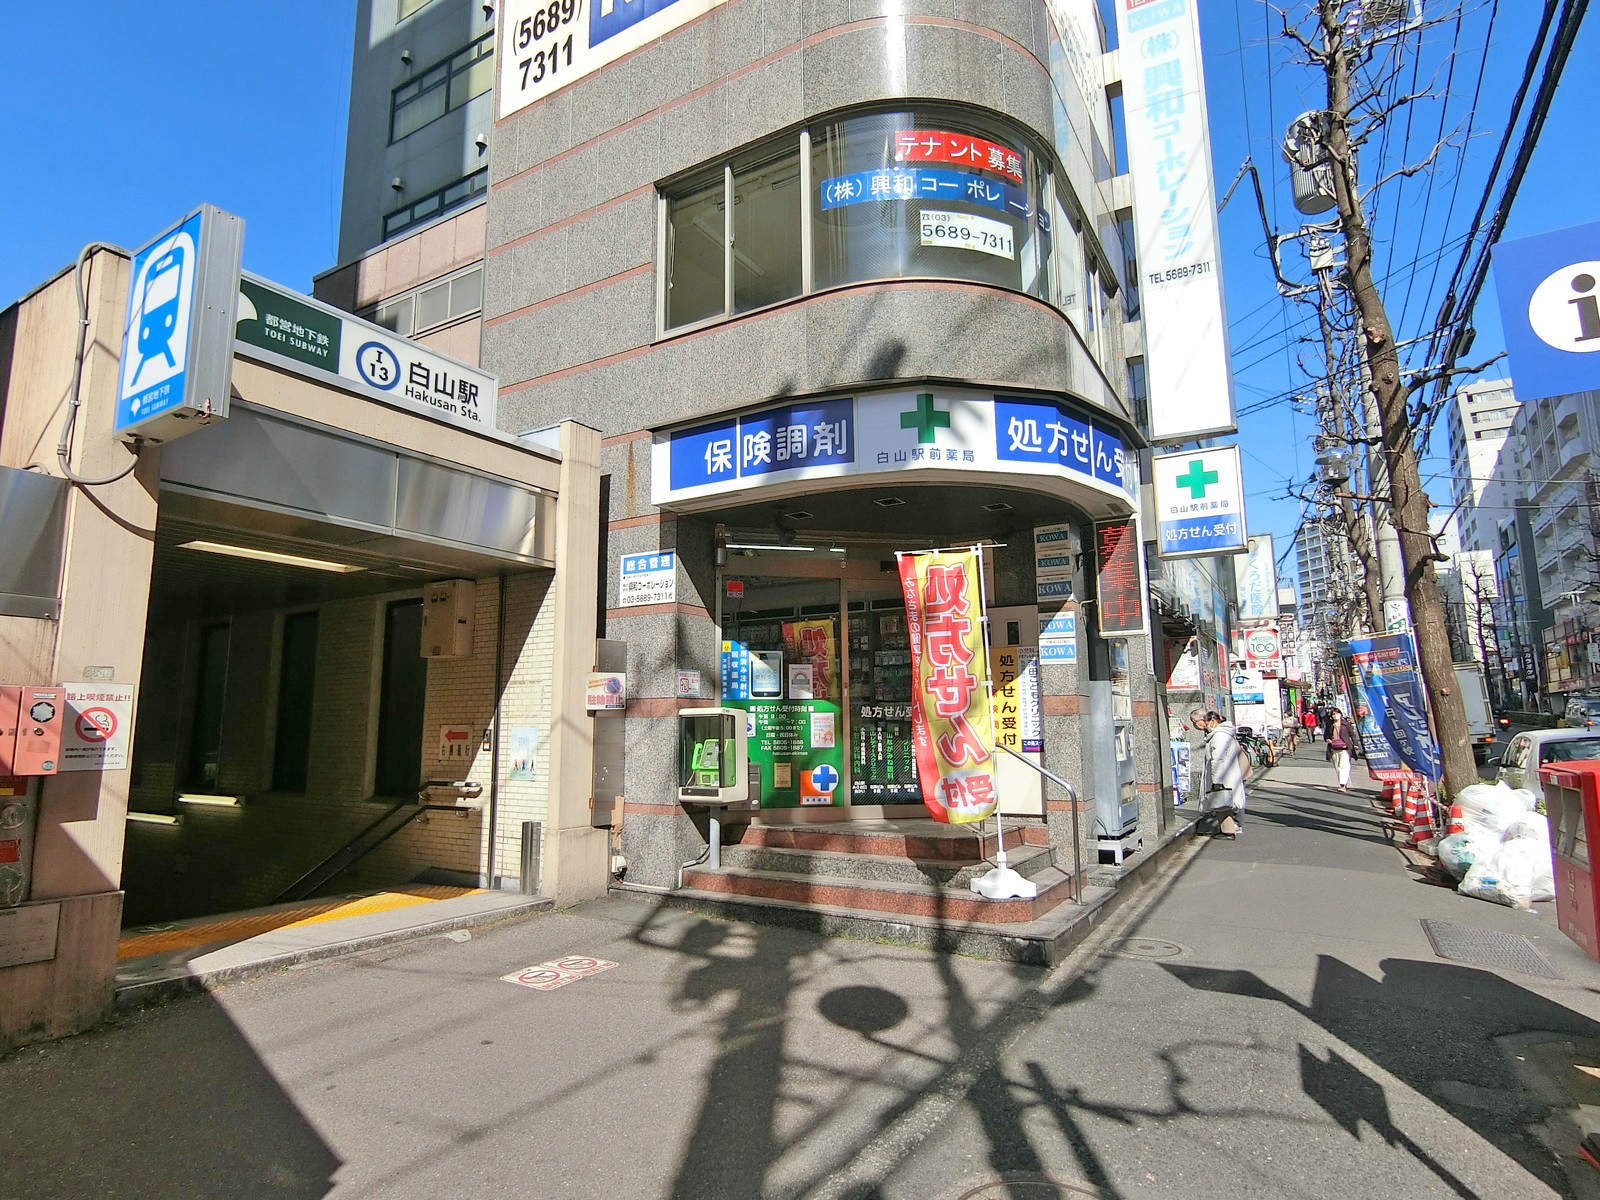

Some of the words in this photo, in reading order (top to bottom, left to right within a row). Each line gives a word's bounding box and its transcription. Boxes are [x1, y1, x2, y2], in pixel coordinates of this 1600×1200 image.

[519, 34, 573, 91] 7311
[898, 136, 1023, 179] テナント募集
[921, 225, 1013, 253] 5689-7311
[1149, 270, 1165, 285] TEL
[1165, 262, 1211, 282] 5689-7311
[265, 313, 330, 347] 都営地下鉄
[264, 327, 286, 342] TOEI
[289, 337, 329, 357] SUBWAY
[370, 363, 389, 381] 13
[408, 362, 479, 407] 白山駅
[405, 385, 457, 414] Hakusan
[461, 405, 482, 422] Sta.
[703, 419, 849, 476] 保険調剤
[876, 446, 976, 465] 白山駅前薬局
[1170, 500, 1229, 514] 白山駅前薬局
[1039, 532, 1066, 542] KOWA
[1165, 522, 1238, 541] 処方せん受付
[626, 555, 671, 572] 総合管理
[1040, 557, 1068, 567] KOWA
[1038, 582, 1072, 595] KOWA
[1248, 558, 1263, 616] くろだ医院
[1040, 620, 1074, 631] KOWA
[1040, 645, 1074, 657] KOWA
[1250, 643, 1275, 652] 100
[588, 694, 624, 705] 駐輪禁止
[756, 705, 808, 713] 処方せん受付時間
[999, 655, 1018, 746] 処方せん受付
